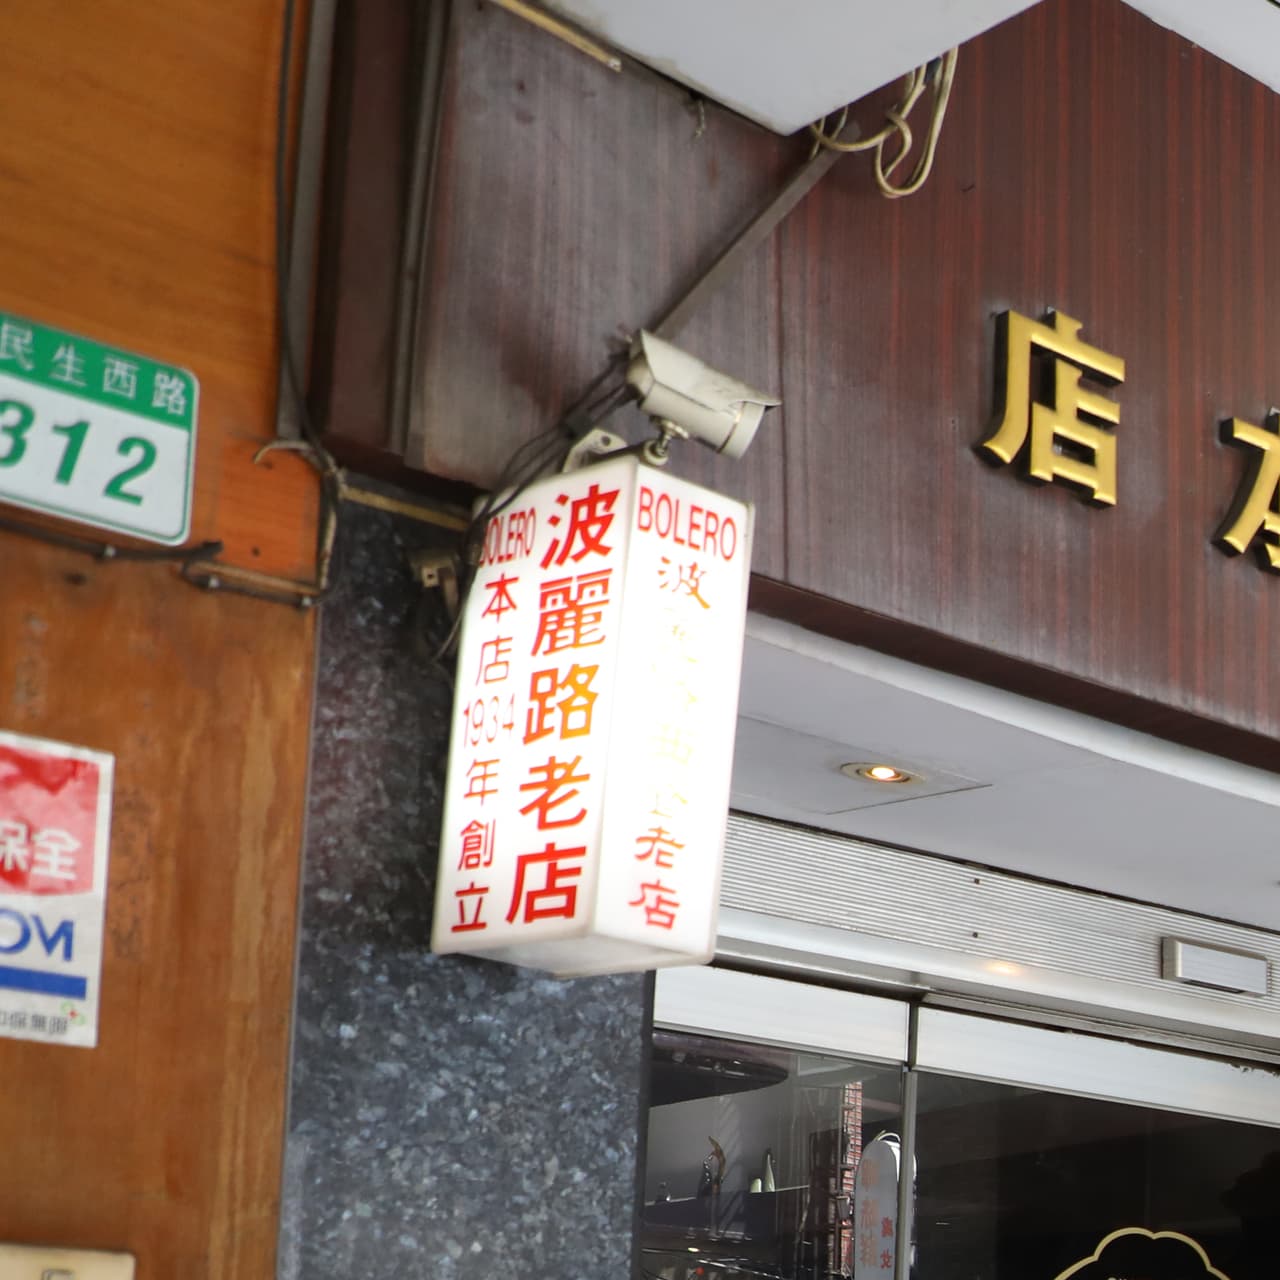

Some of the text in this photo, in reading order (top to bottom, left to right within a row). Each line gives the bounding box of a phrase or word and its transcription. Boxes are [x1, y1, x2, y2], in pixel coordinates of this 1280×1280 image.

[0, 321, 187, 417] 民生西路
[0, 399, 157, 506] 312
[637, 485, 738, 562] BOLERO
[451, 573, 519, 933] 本店1934年創立
[505, 483, 621, 925] 波麗路老店
